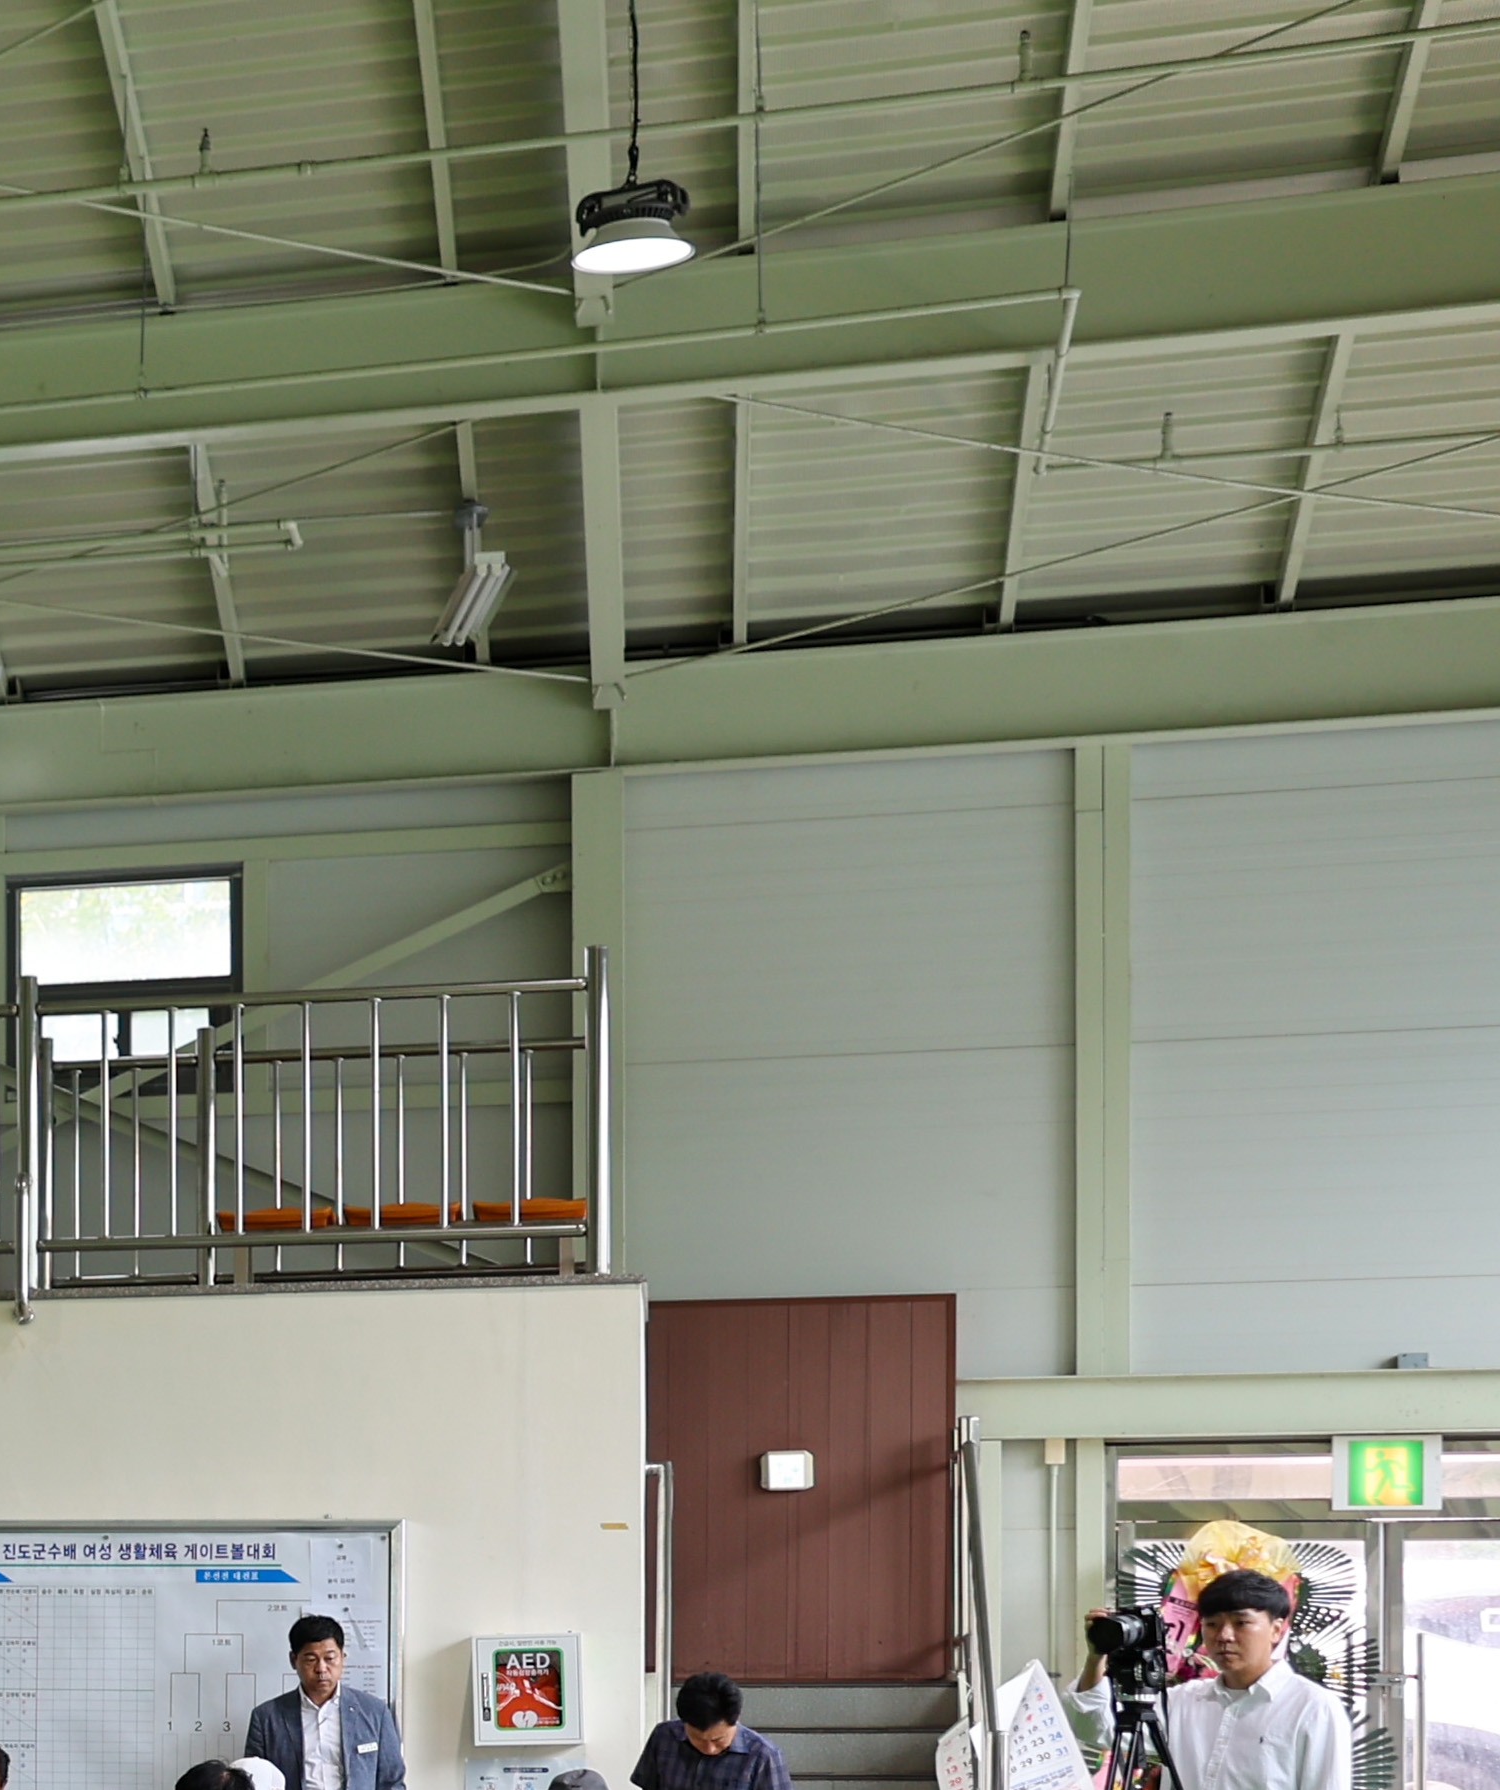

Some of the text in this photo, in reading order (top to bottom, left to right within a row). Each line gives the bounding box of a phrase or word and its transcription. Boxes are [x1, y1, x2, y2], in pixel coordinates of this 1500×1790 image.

[3, 1543, 77, 1561] 진도군수배
[83, 1543, 112, 1560] 여성
[118, 1542, 178, 1560] 생활체육
[184, 1542, 276, 1560] 게이트볼대회
[506, 1653, 550, 1669] AED
[168, 1721, 231, 1731] 1 2 3
[1042, 1717, 1055, 1727] 17
[1031, 1737, 1045, 1747] 23
[1048, 1731, 1063, 1742] 24
[1020, 1758, 1033, 1768] 29
[1036, 1752, 1051, 1762] 30
[1055, 1746, 1069, 1757] 31
[949, 1776, 962, 1787] 20
